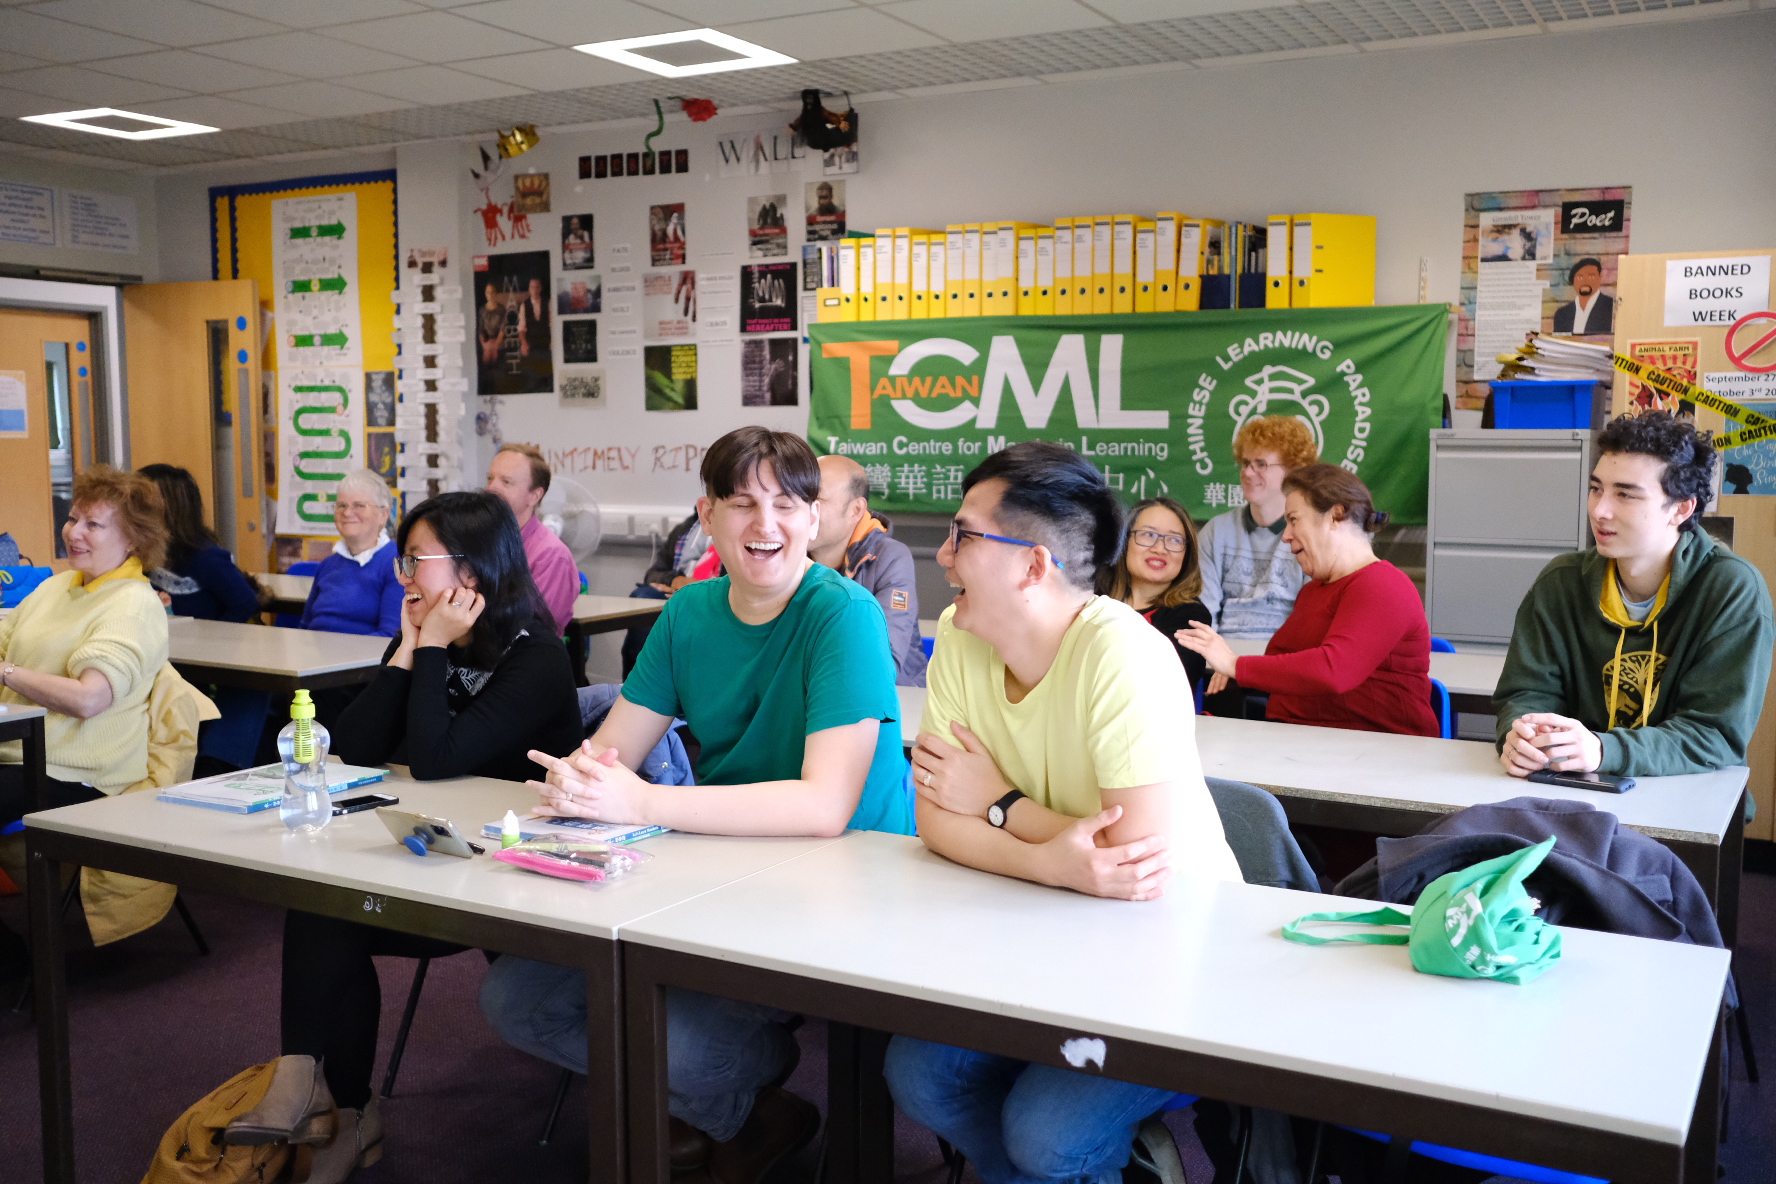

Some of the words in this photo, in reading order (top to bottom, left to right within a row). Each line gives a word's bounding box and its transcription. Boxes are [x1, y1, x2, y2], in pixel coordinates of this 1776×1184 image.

[1569, 206, 1616, 230] Poet
[1683, 263, 1752, 278] BANNED
[1688, 286, 1744, 300] BOOKS
[1692, 309, 1738, 322] WEEK
[1638, 345, 1667, 353] ANIMAL
[1669, 345, 1690, 353] FARM
[821, 333, 1170, 430] TCML
[1705, 373, 1761, 384] September
[1646, 369, 1690, 396] CAUTION
[1695, 391, 1741, 418] CAUTION
[1748, 387, 1762, 397] 3rd
[1186, 373, 1217, 475] CHINESE
[1215, 330, 1334, 370] LEARNING
[1336, 359, 1372, 474] PARADISE
[826, 436, 887, 455] Taiwan
[892, 435, 953, 455] Centre
[958, 436, 981, 455] for
[1081, 435, 1169, 460] Learning
